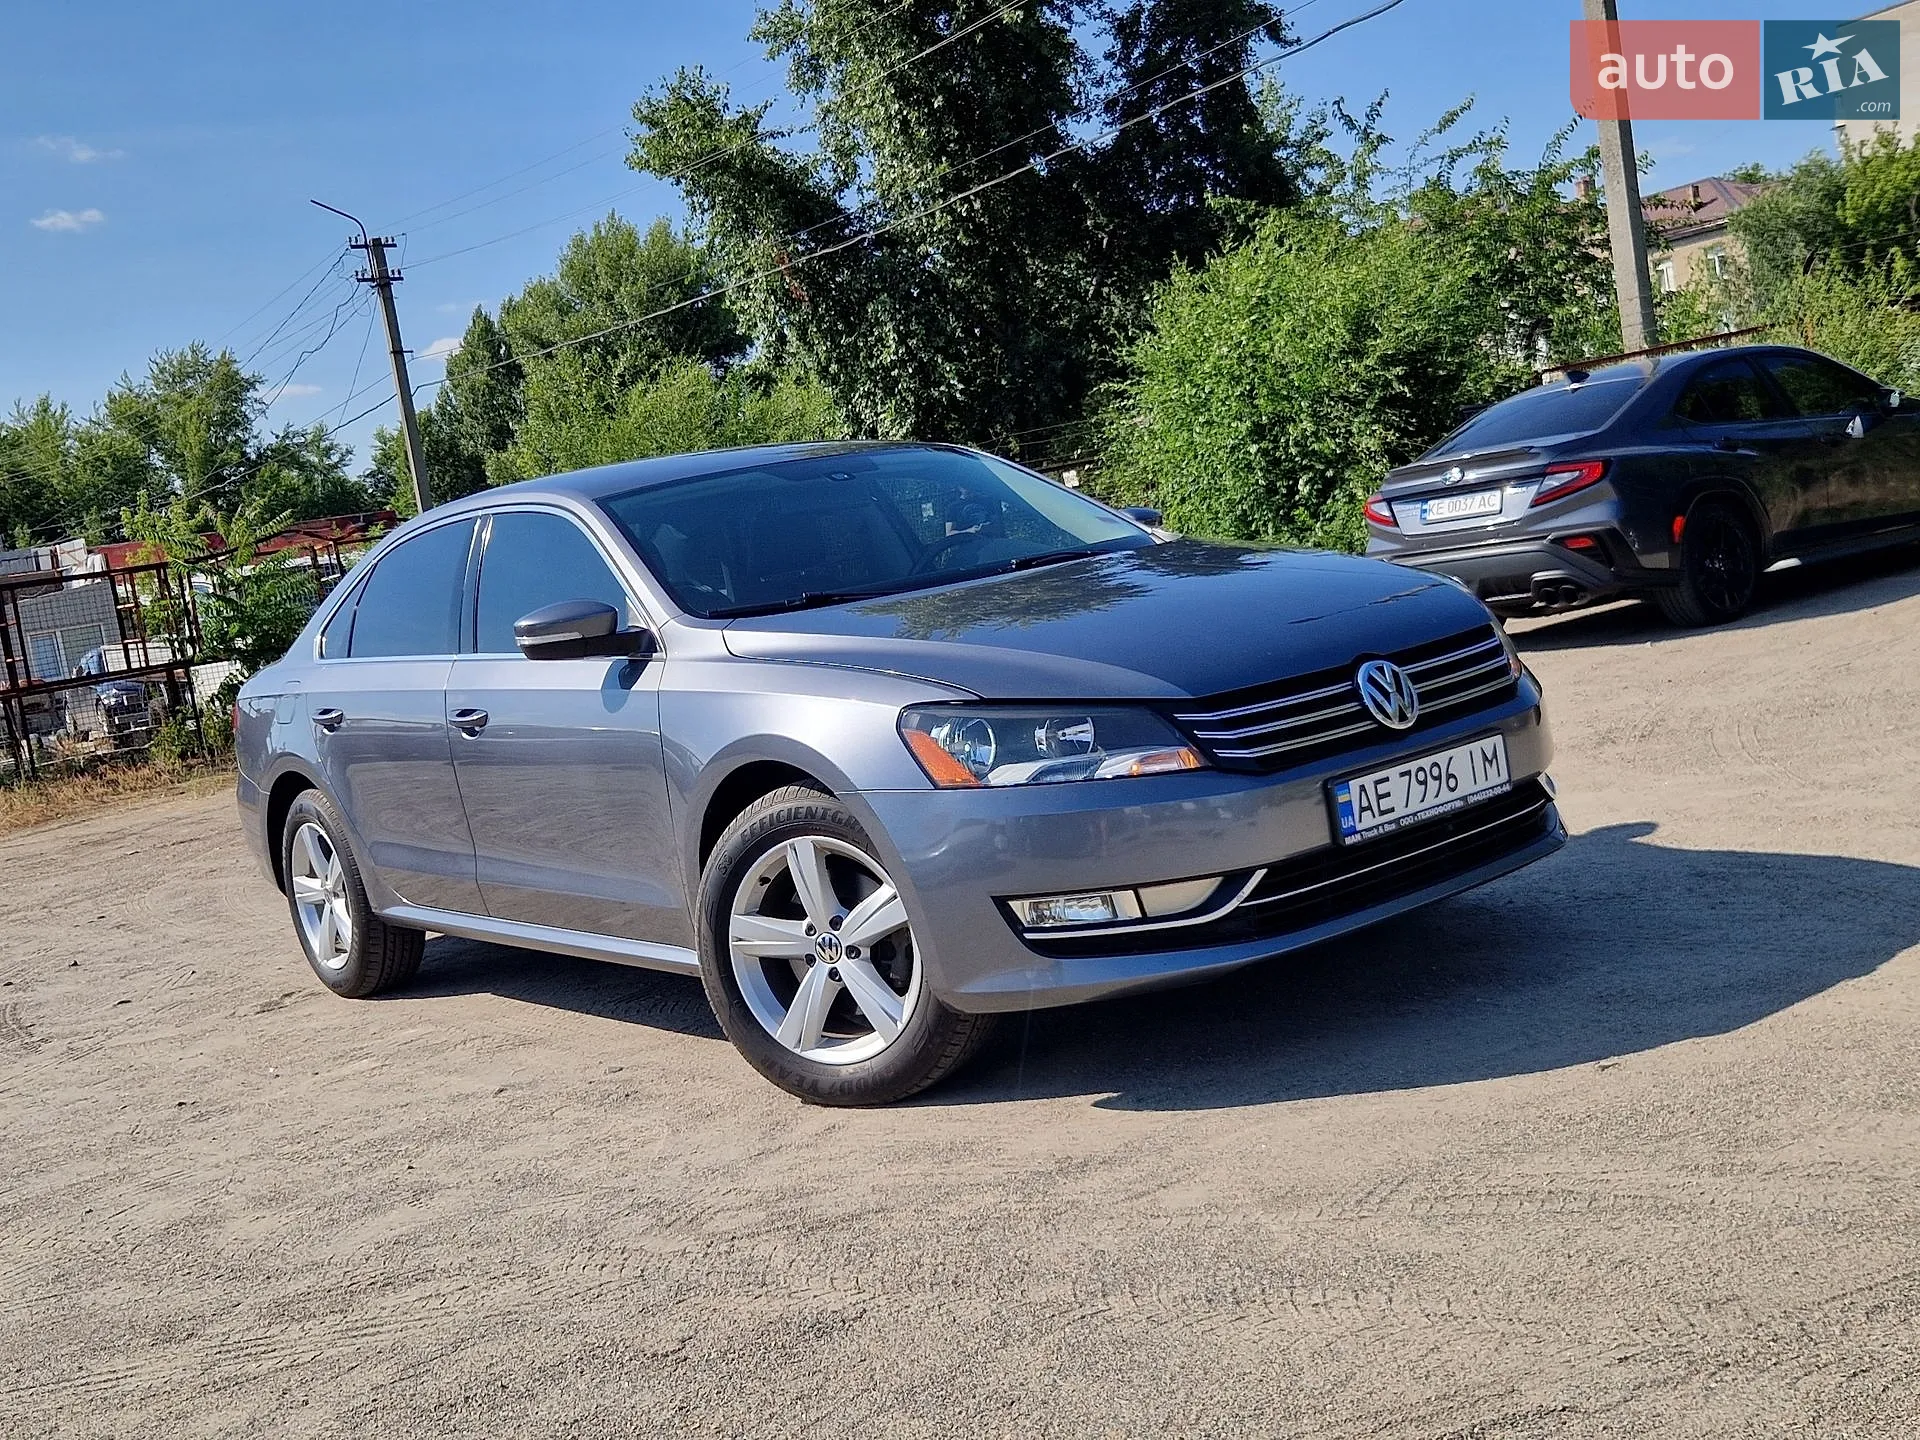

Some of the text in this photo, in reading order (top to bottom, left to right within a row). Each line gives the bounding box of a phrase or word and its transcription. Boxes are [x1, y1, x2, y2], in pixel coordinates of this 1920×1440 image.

[1428, 502, 1445, 516] KE
[1447, 497, 1476, 514] 0037
[1478, 494, 1496, 509] AC
[1358, 741, 1501, 824] AE 7996 IM
[1340, 815, 1355, 829] UA
